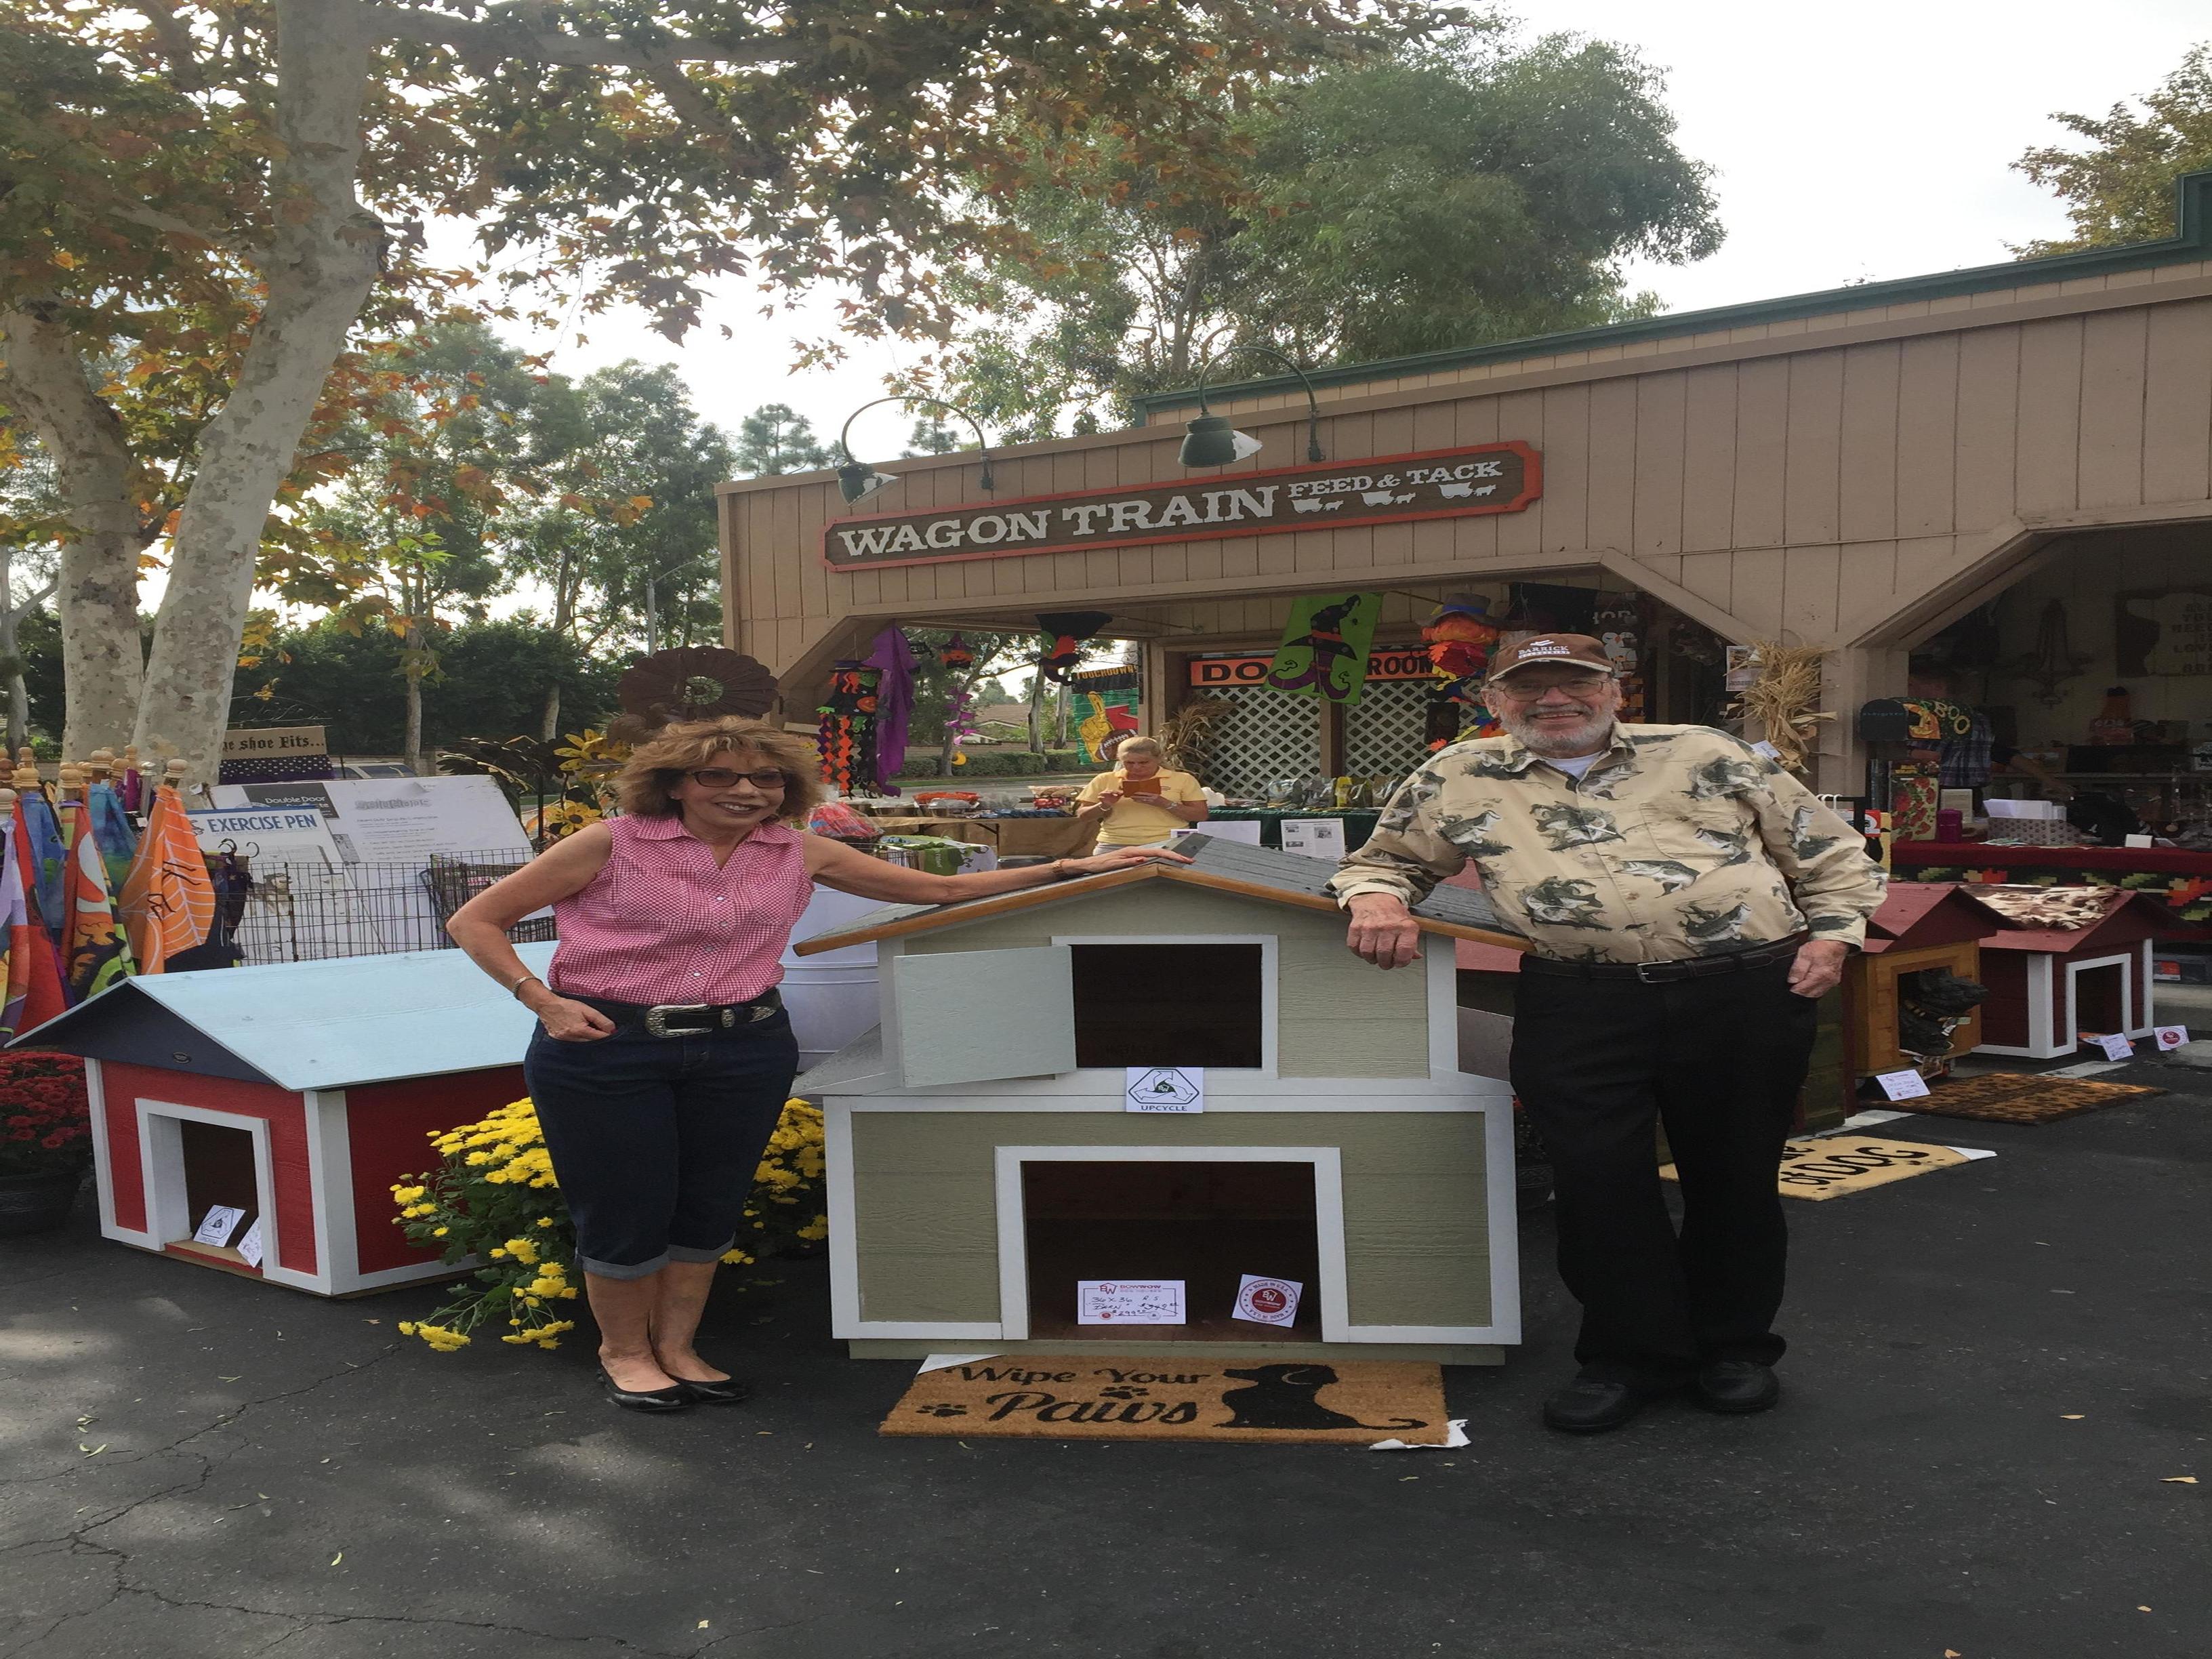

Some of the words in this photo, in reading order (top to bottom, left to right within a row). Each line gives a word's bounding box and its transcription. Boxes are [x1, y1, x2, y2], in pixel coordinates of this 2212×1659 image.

[838, 510, 1052, 556] WAGON
[1062, 485, 1279, 536] TRAIN
[1288, 475, 1374, 498] FEED
[1377, 474, 1401, 488] &
[1406, 461, 1503, 485] TACK
[1518, 645, 1569, 655] BARRICK
[1202, 661, 1267, 682] DO
[1933, 700, 1971, 735] BOO
[238, 737, 274, 751] shoe
[207, 816, 283, 833] EXERCISE
[284, 814, 318, 829] PEN
[945, 1366, 1076, 1385] Wipe
[1093, 1368, 1211, 1385] Your
[986, 1391, 1198, 1424] Paws
